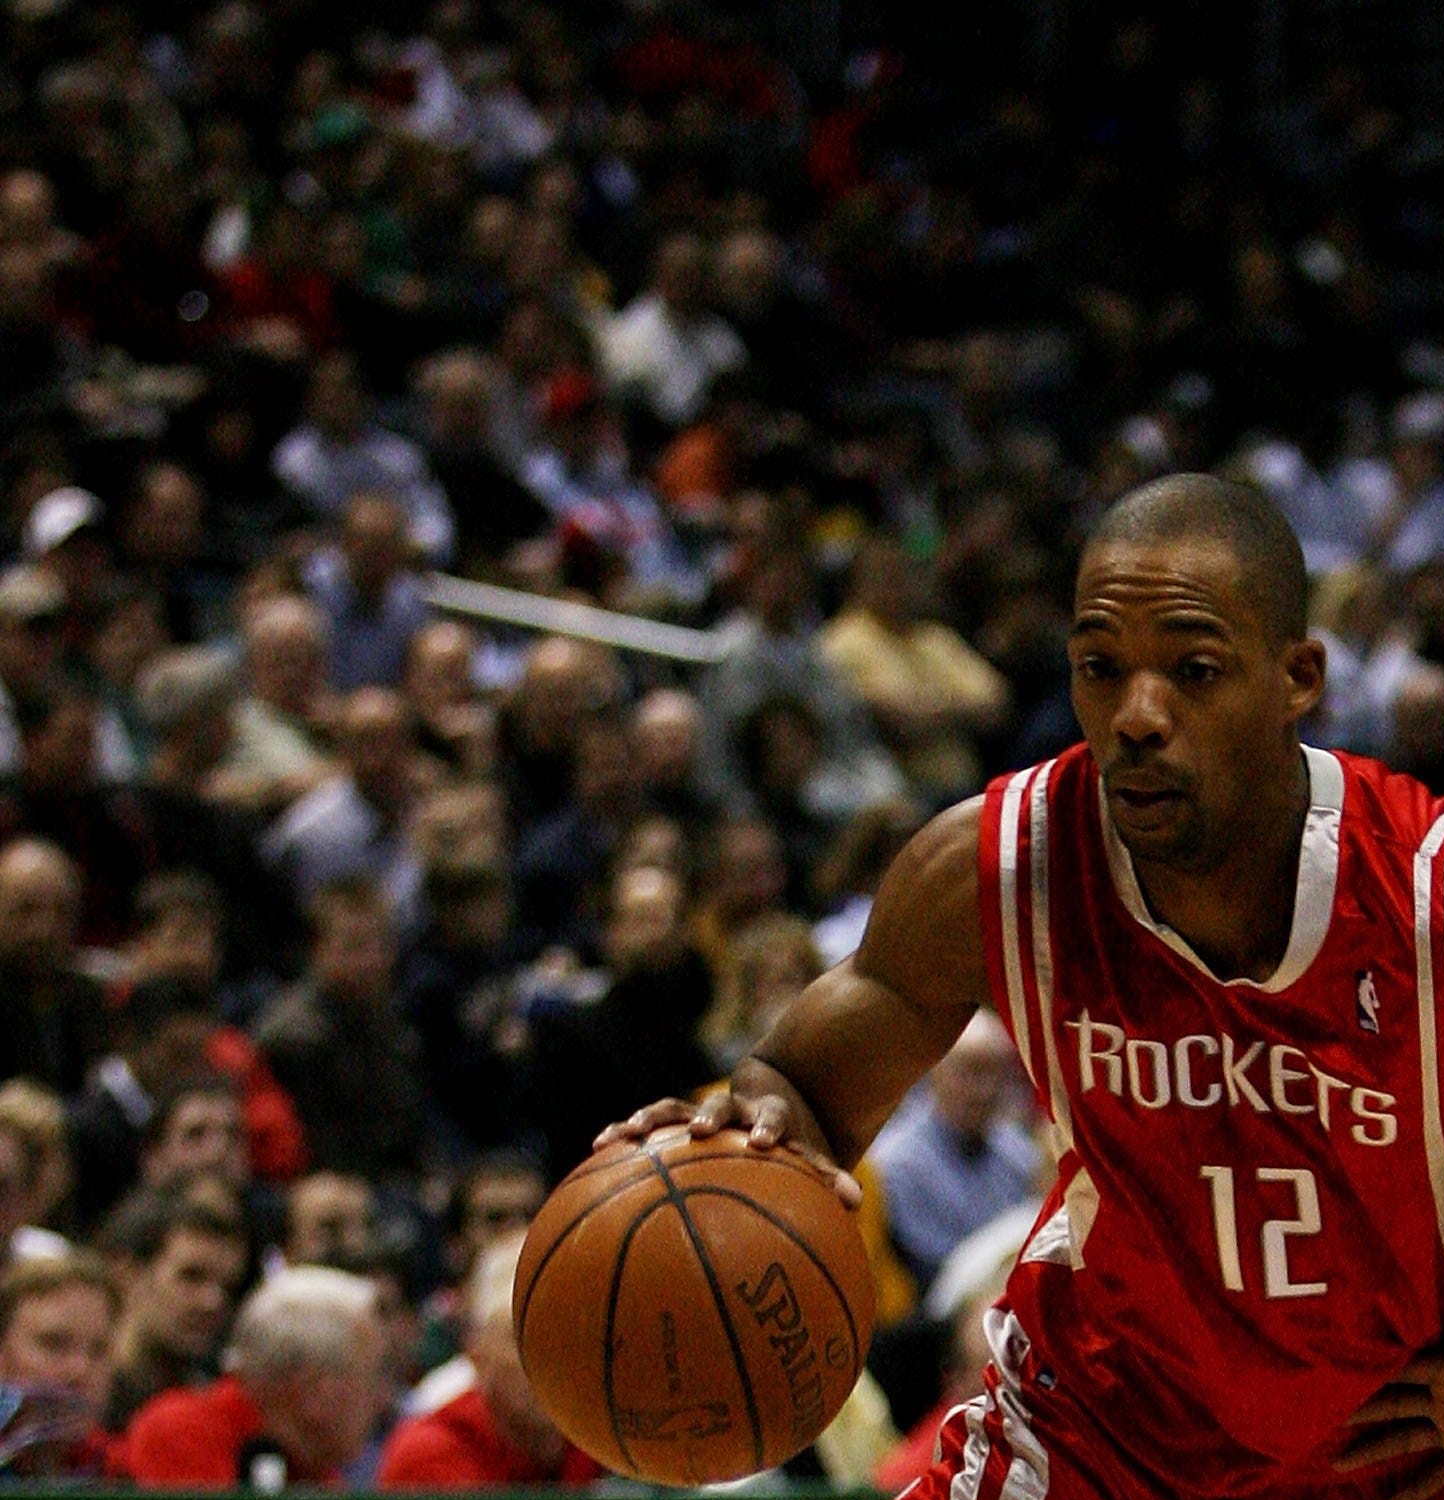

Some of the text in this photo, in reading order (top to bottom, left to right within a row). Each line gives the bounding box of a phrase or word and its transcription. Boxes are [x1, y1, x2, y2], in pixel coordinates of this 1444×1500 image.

[1064, 1008, 1398, 1147] ROCKETS
[1200, 1165, 1328, 1299] 12
[735, 1261, 826, 1440] SPALD
